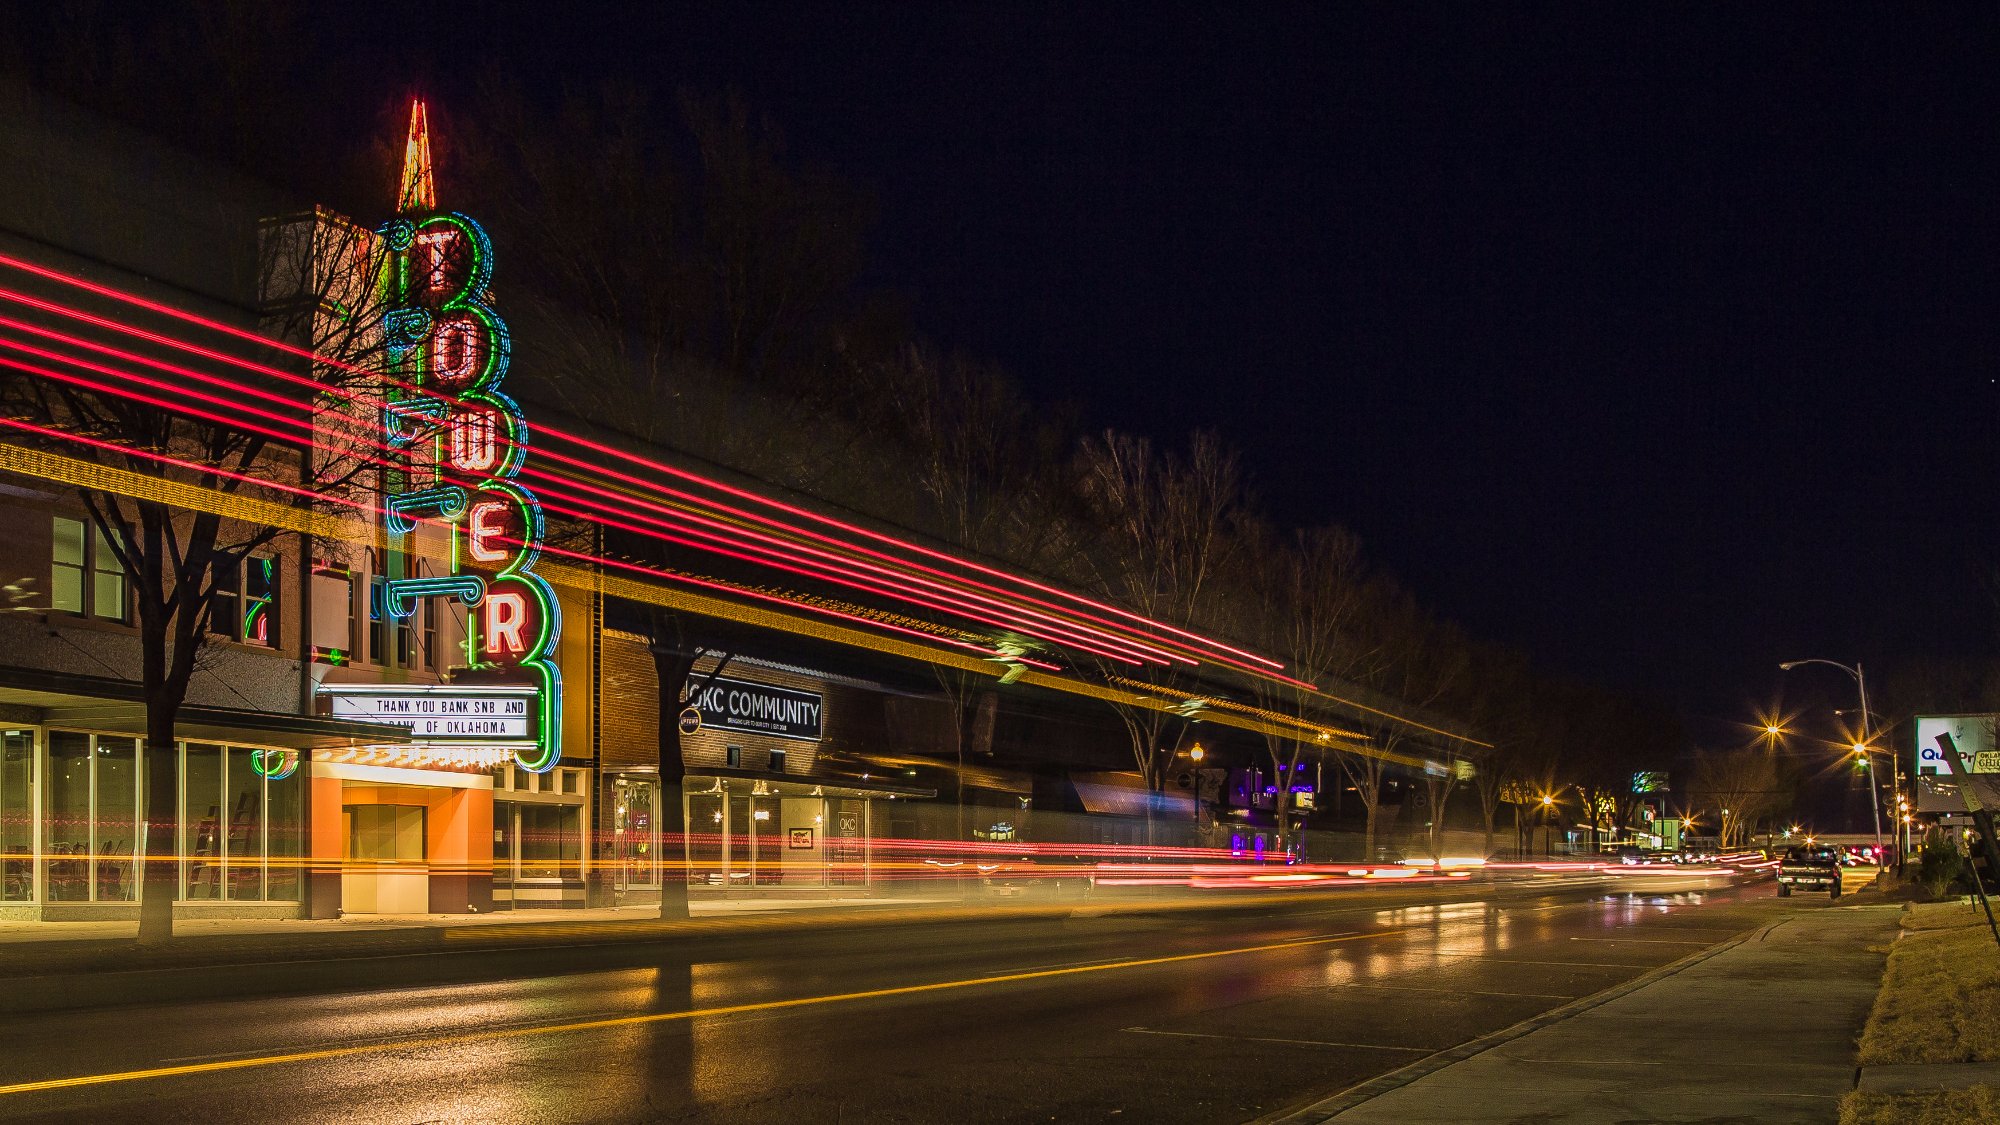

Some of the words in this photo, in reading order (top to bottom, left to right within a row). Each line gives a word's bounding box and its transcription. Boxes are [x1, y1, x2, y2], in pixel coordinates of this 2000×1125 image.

[418, 230, 526, 654] TOWER
[377, 700, 410, 713] THANK
[415, 701, 435, 713] YOU
[441, 701, 469, 713] BANK
[474, 701, 495, 713] SNB
[505, 702, 524, 714] AND
[689, 683, 724, 713] OKC
[729, 690, 820, 727] COMMUNITY
[426, 721, 439, 733] OF
[447, 721, 506, 734] OKLAHOMA
[839, 818, 856, 831] OKC
